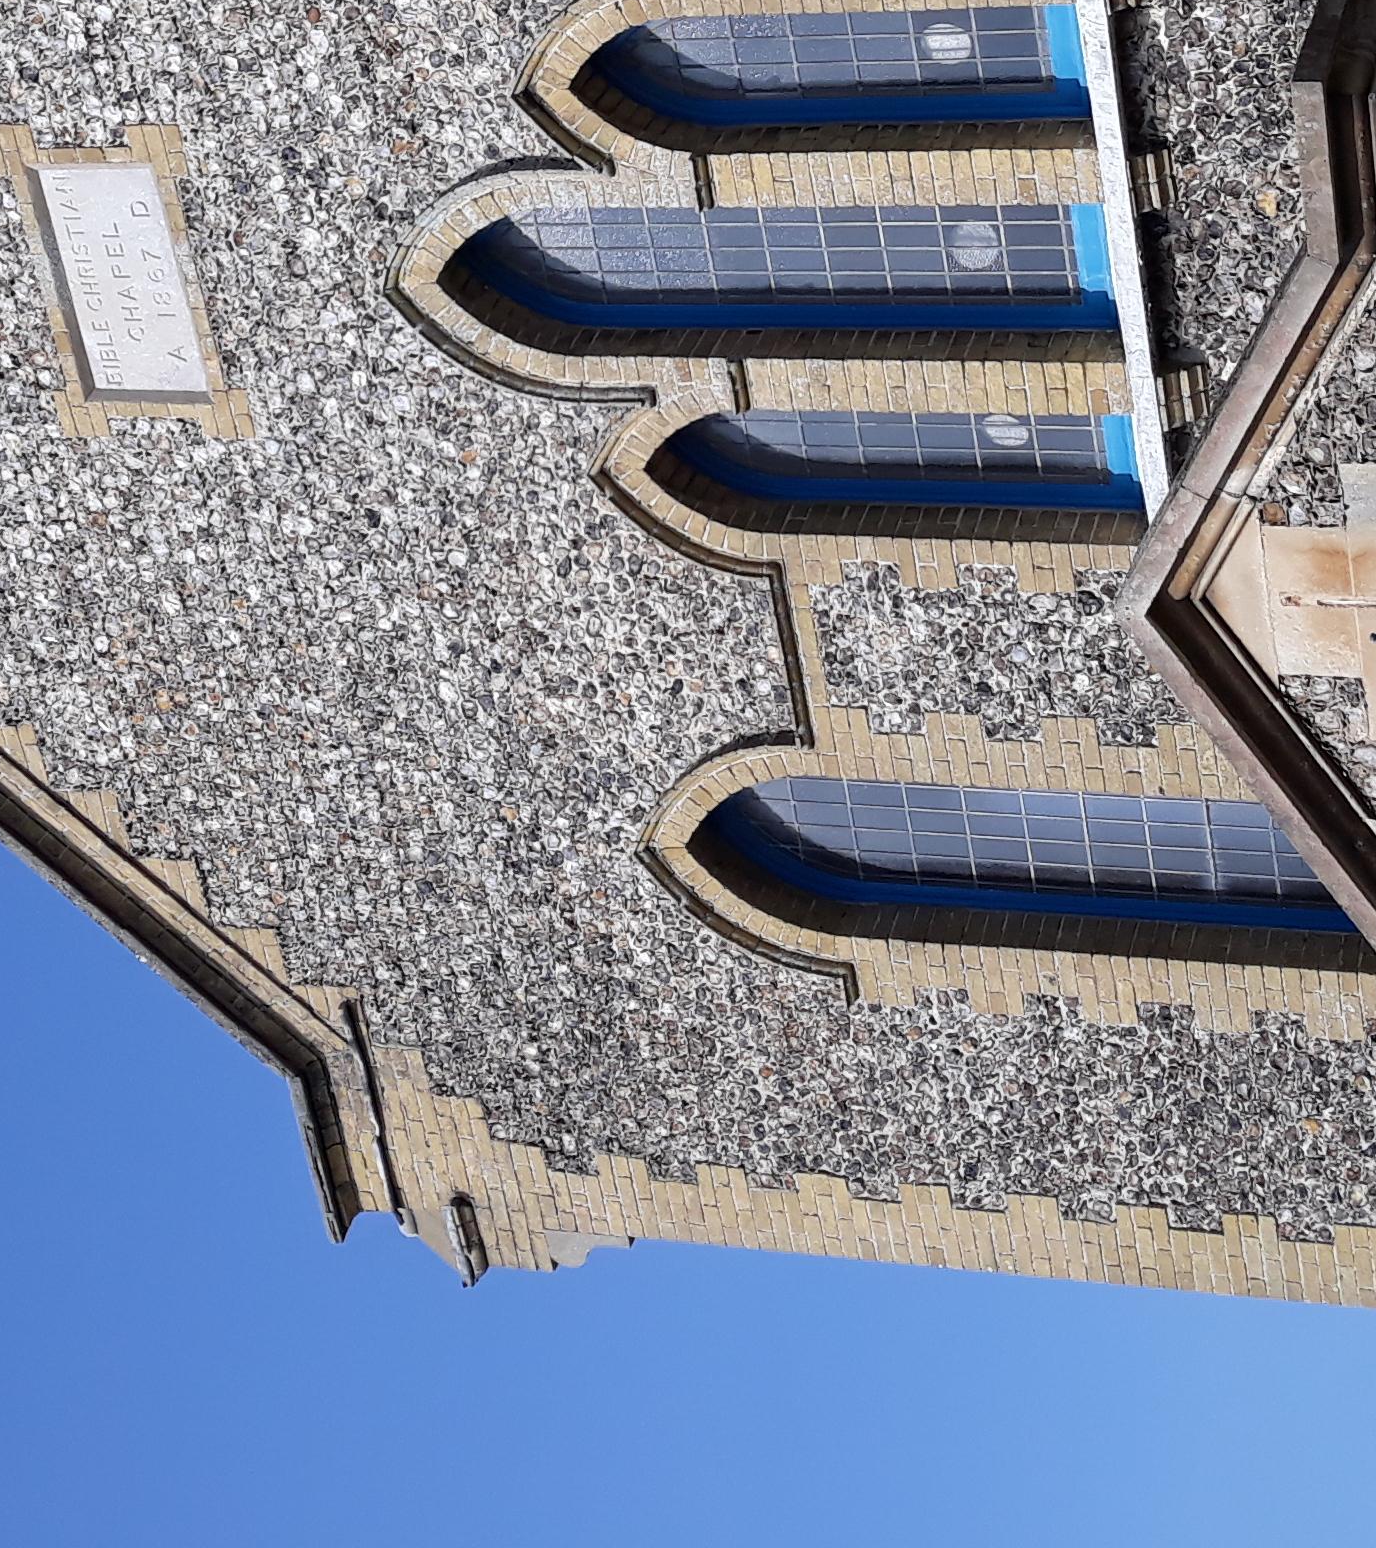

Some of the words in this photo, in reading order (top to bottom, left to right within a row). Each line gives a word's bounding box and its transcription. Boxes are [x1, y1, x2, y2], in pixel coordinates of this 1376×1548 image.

[129, 200, 151, 217] D
[52, 176, 103, 311] CHRISTIAN
[102, 222, 145, 342] CHAPEL
[141, 249, 176, 317] 1867
[91, 320, 124, 387] BIBLE
[167, 346, 188, 363] A
